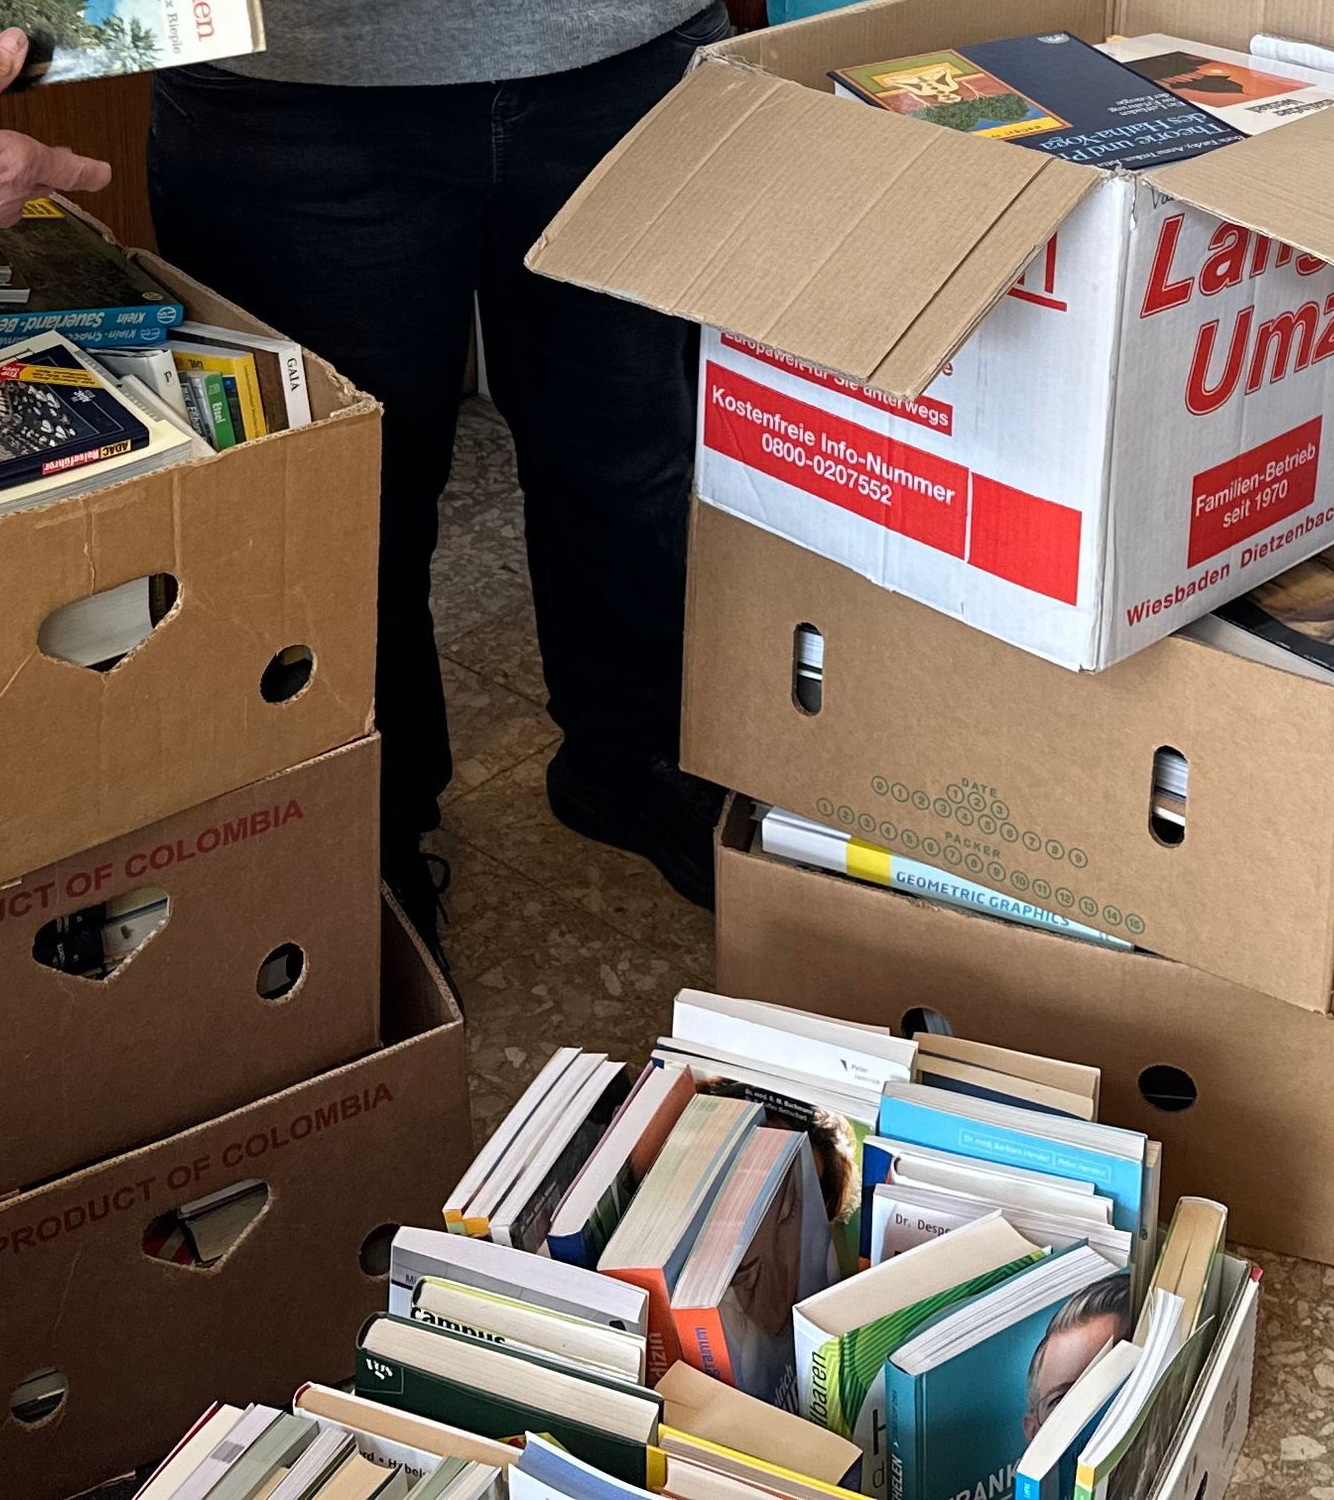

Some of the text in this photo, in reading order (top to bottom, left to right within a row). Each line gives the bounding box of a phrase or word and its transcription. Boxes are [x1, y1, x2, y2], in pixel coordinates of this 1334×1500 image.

[1038, 119, 1169, 151] Hatha-Yoga
[1134, 122, 1229, 147] Theorie
[1166, 112, 1208, 127] des
[1089, 138, 1135, 160] und
[116, 311, 145, 325] Klein
[287, 358, 300, 392] GAIA
[213, 401, 226, 424] Etzel
[101, 441, 128, 457] ADAC
[710, 384, 956, 505] Kostenfreie Info-Nummer
[761, 432, 893, 506] 0800-0207552
[1194, 441, 1317, 518] Familien-Betrieb
[1222, 479, 1288, 530] seit 1970
[1126, 560, 1232, 628] Wiesbaden
[961, 777, 997, 799] DATE
[65, 861, 114, 901] OF
[123, 797, 306, 880] COLOMBIA
[944, 830, 1001, 860] PACKER
[896, 871, 1070, 927] GEOMETRIC GRAPHICS
[166, 1153, 212, 1196] OF
[219, 1081, 395, 1163] COLOMBIA
[895, 1214, 911, 1227] Dr.
